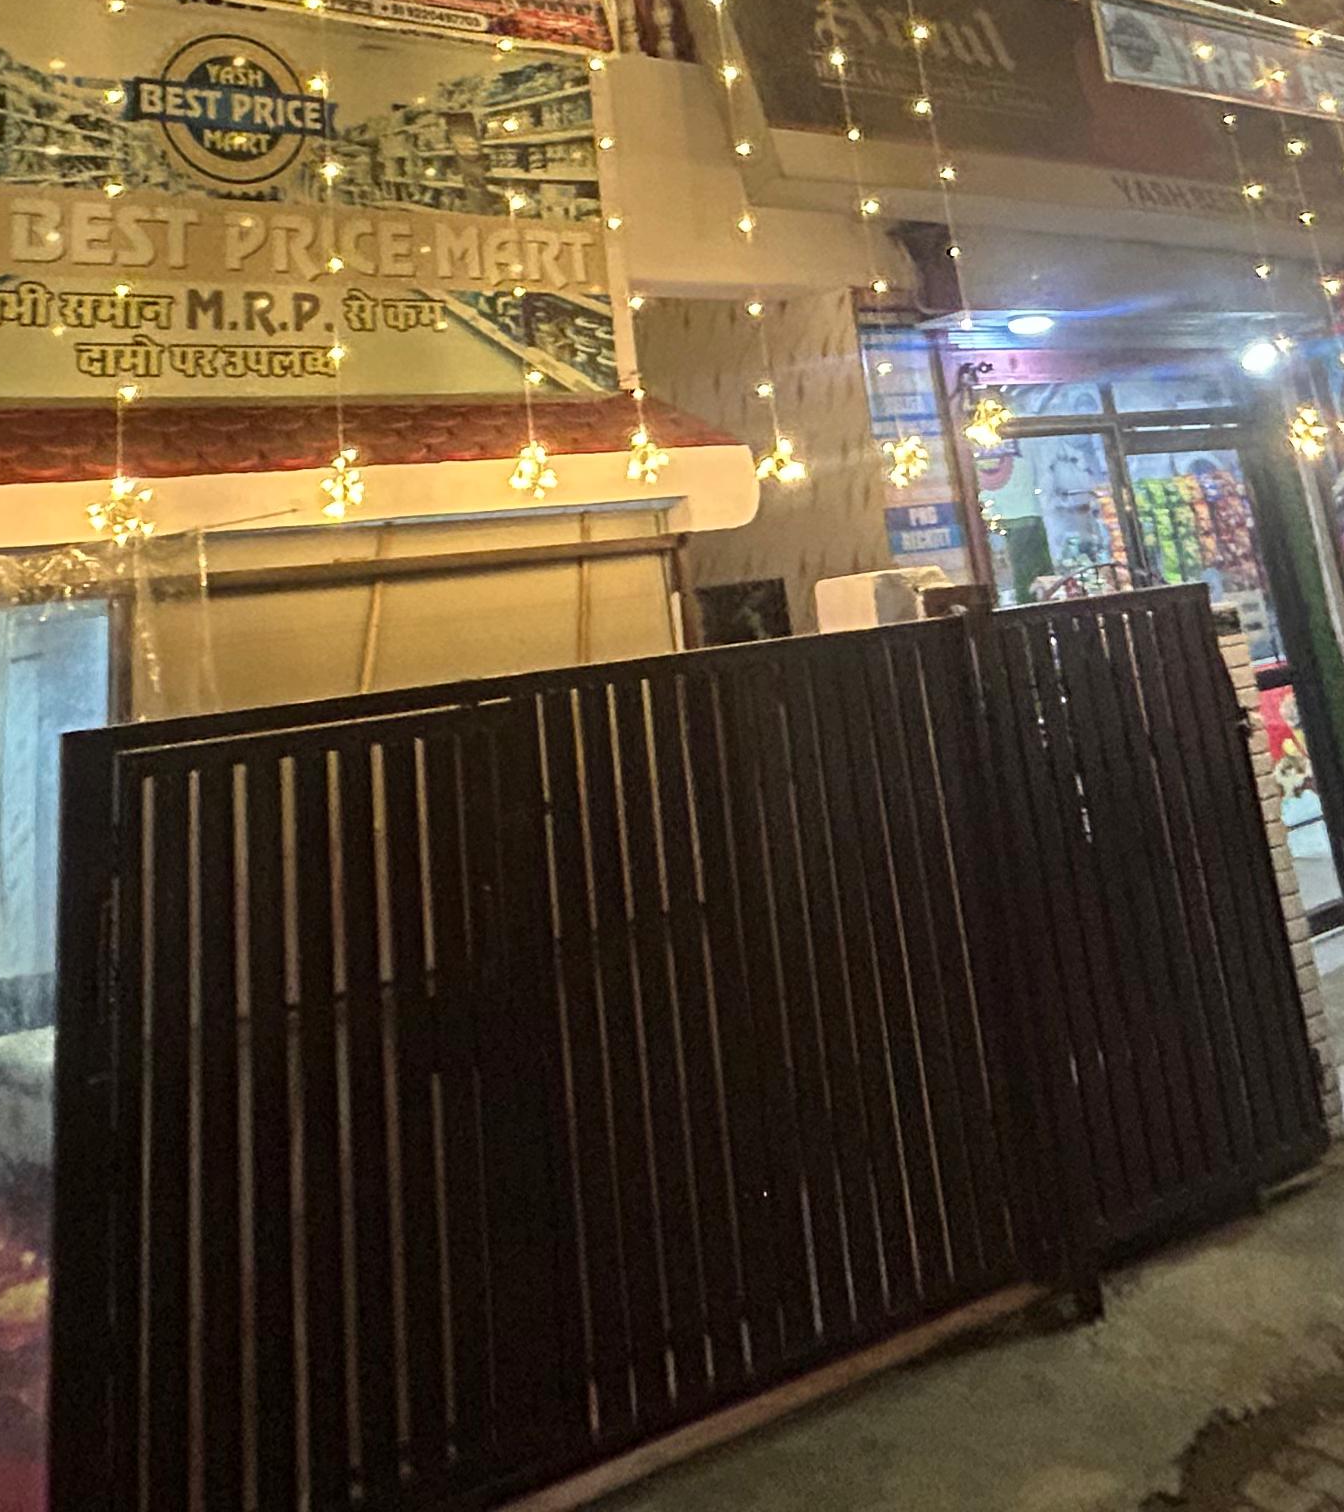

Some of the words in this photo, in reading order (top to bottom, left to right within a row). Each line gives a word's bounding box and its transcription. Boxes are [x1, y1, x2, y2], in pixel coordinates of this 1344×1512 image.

[207, 62, 265, 88] YASH
[139, 82, 223, 120] BEST
[229, 92, 323, 130] PRICE
[203, 128, 271, 154] MART
[1112, 175, 1192, 209] YASH
[10, 198, 202, 269] BEST
[224, 210, 418, 281] PRICE
[436, 223, 594, 288] MART
[59, 292, 174, 330] समान
[186, 288, 334, 336] M.R.P.
[343, 287, 378, 332] से
[382, 298, 448, 332] कम
[74, 333, 164, 377] दामो
[169, 344, 219, 378] पर
